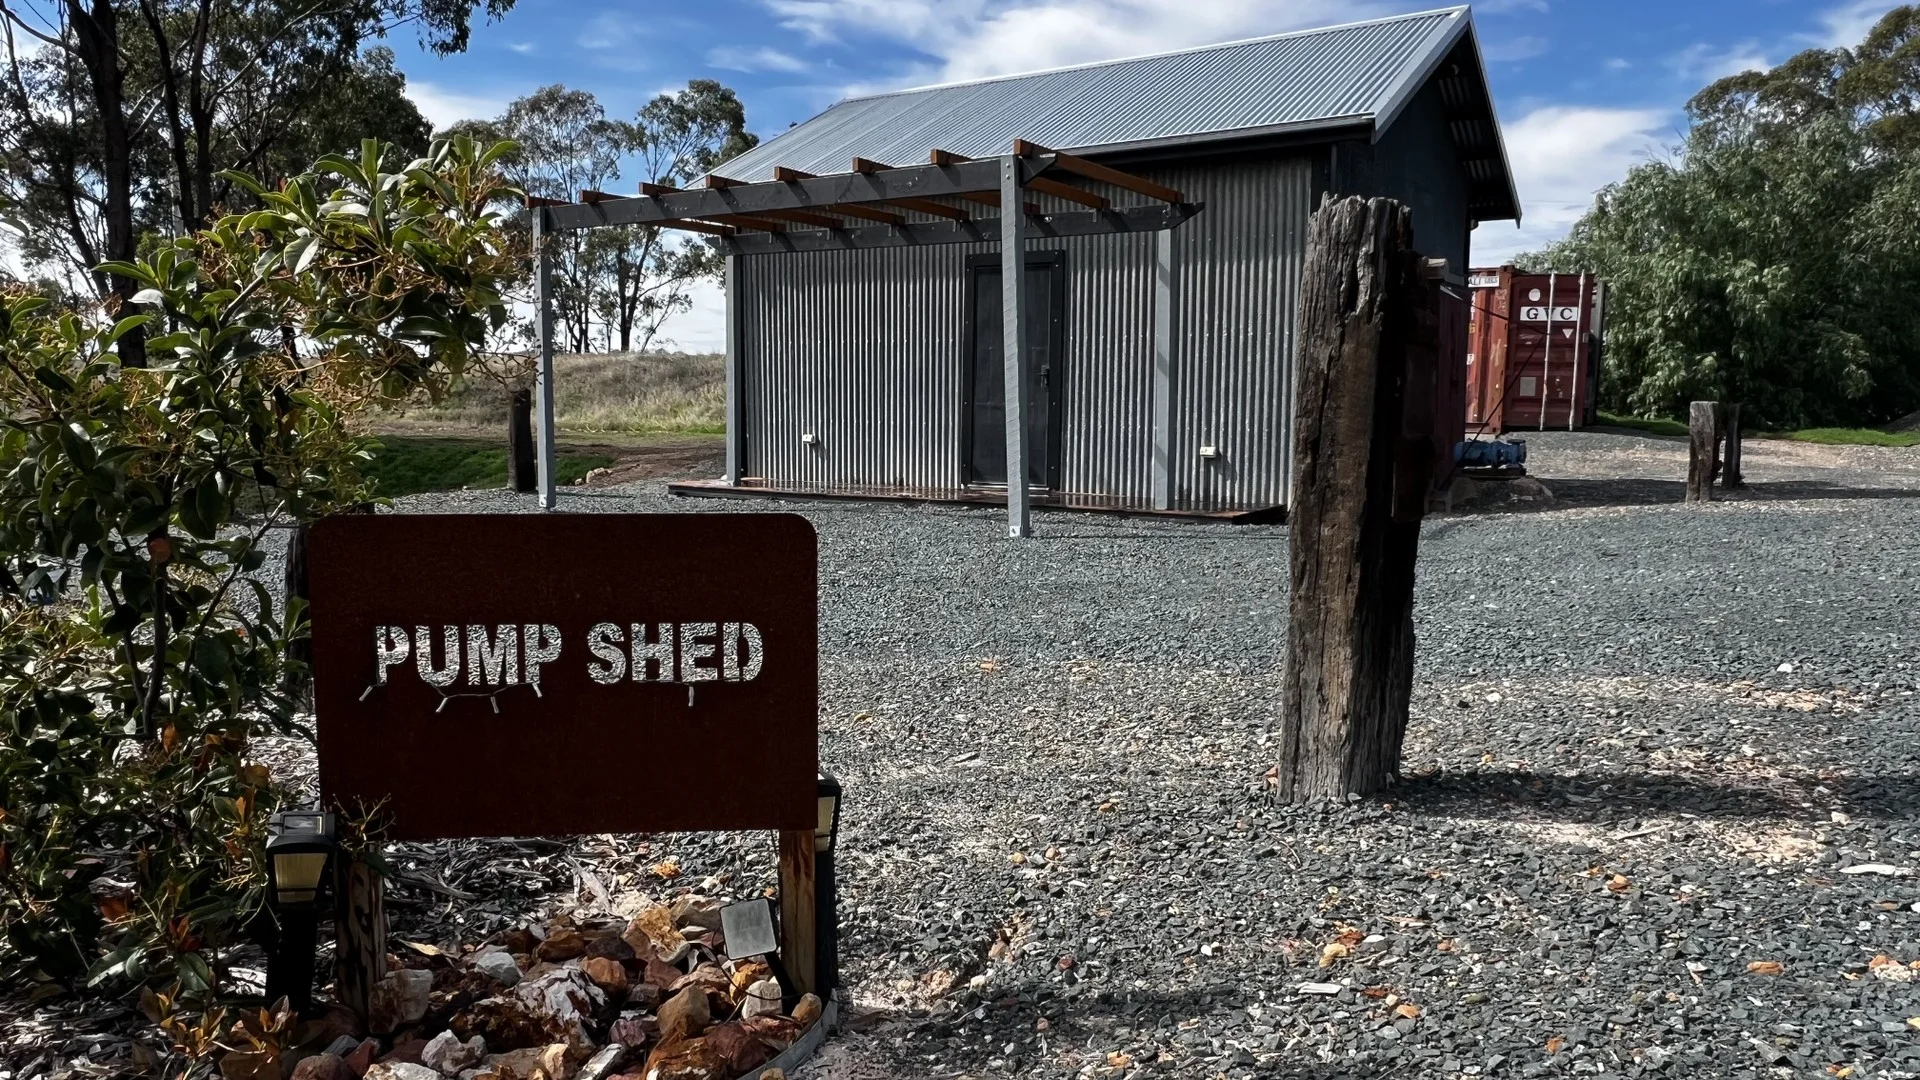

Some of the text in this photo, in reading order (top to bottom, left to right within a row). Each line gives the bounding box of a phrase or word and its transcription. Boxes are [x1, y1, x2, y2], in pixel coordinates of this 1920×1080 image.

[1526, 308, 1573, 320] GVC
[375, 622, 763, 685] PUMP SHED
